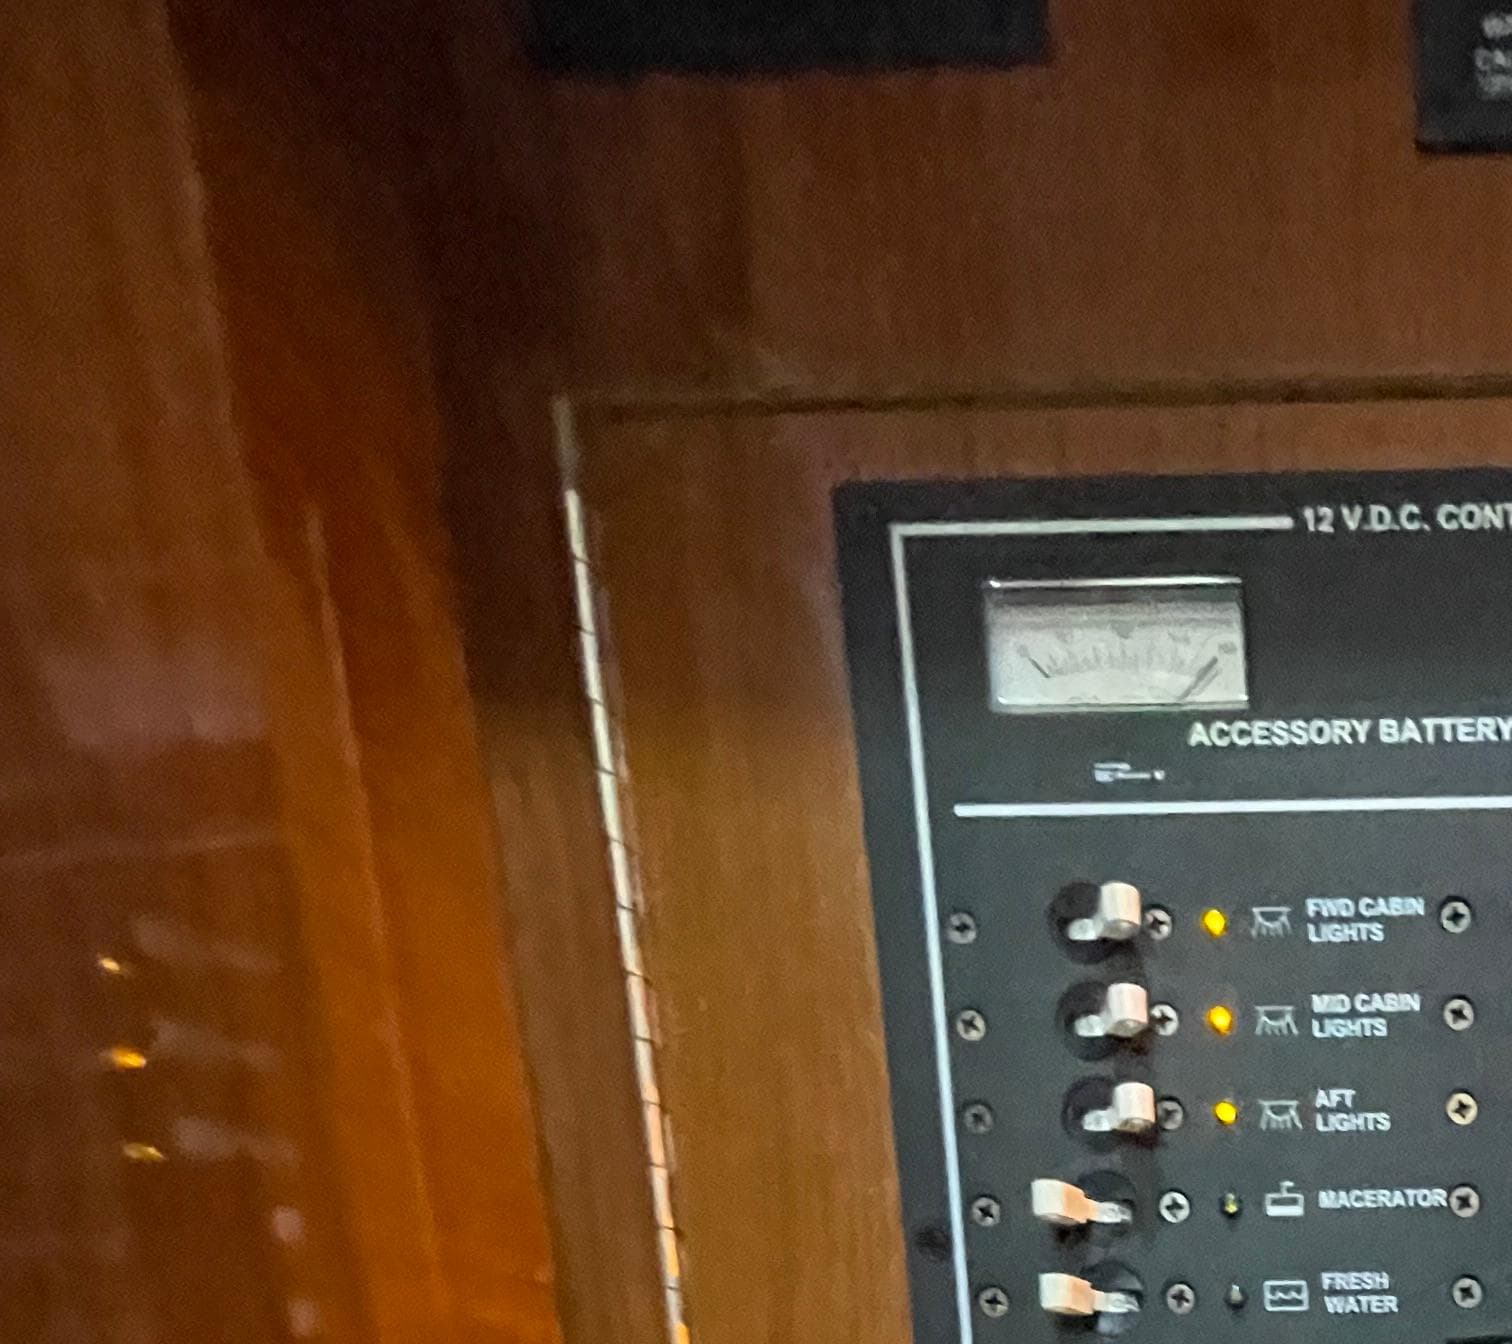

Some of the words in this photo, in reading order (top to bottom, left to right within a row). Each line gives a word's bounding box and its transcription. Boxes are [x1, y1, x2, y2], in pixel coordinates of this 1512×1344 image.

[1304, 506, 1334, 532] 12
[1341, 504, 1430, 531] V.D.C.
[1187, 719, 1371, 747] ACCESSORY
[1306, 897, 1354, 917] FWD
[1359, 896, 1424, 916] CABIN
[1307, 923, 1384, 942] LIGHTS
[1311, 994, 1350, 1013] MID
[1354, 992, 1421, 1012] CABIN
[1312, 1018, 1388, 1037] LIGHTS
[1315, 1089, 1356, 1107] AFT
[1316, 1112, 1391, 1131] LIGHTS
[1318, 1189, 1448, 1208] MACERATOR
[1321, 1271, 1389, 1290] FRESH
[1324, 1295, 1398, 1313] WATER
